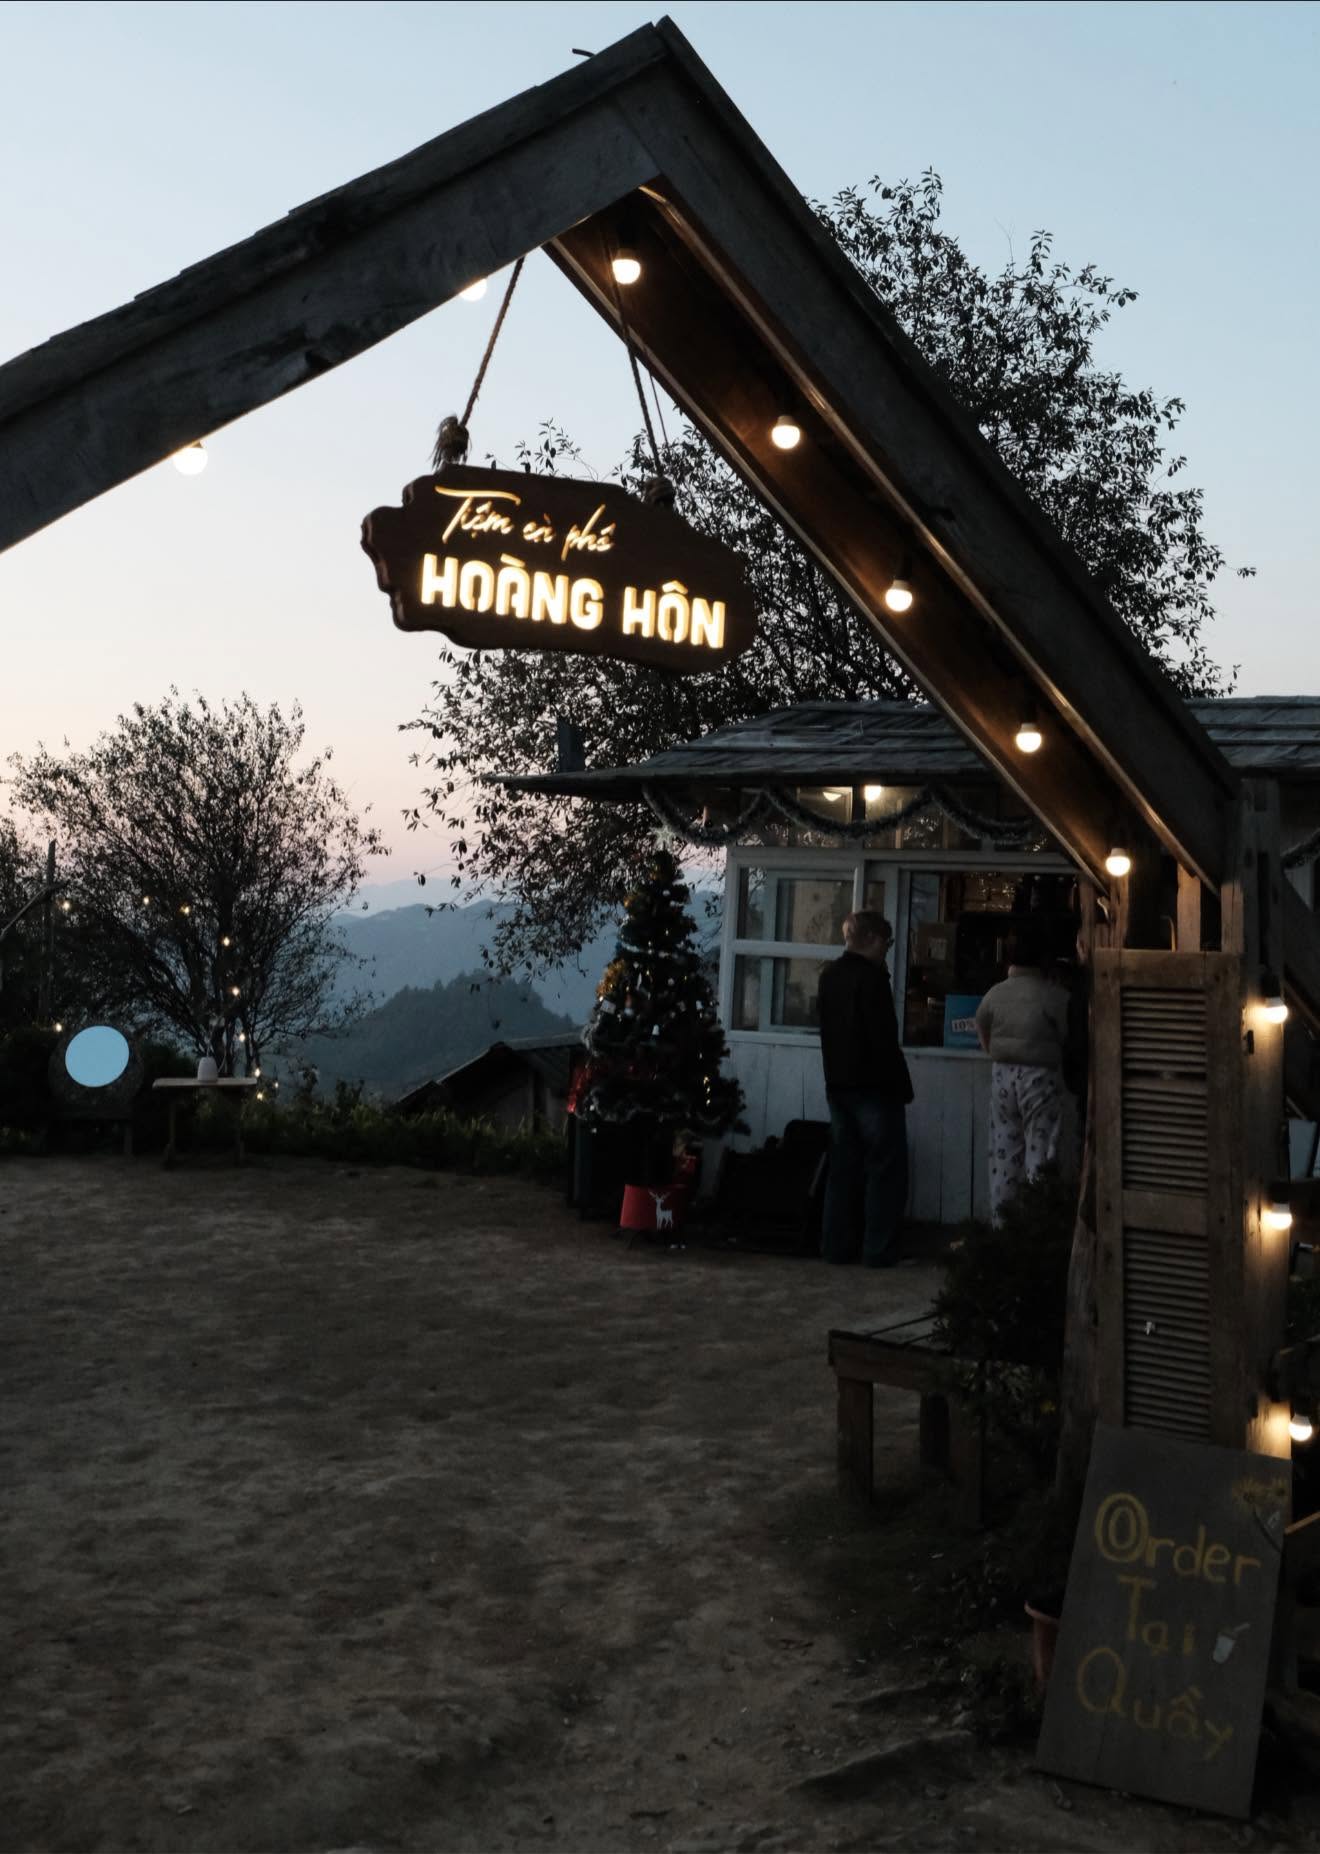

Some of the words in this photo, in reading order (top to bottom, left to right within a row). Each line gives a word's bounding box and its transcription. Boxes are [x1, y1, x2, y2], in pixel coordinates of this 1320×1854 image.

[434, 485, 521, 544] Tiệm
[560, 504, 617, 562] phê
[420, 553, 604, 630] HOÀNG
[622, 580, 726, 649] HÔN
[1095, 1492, 1261, 1585] Order
